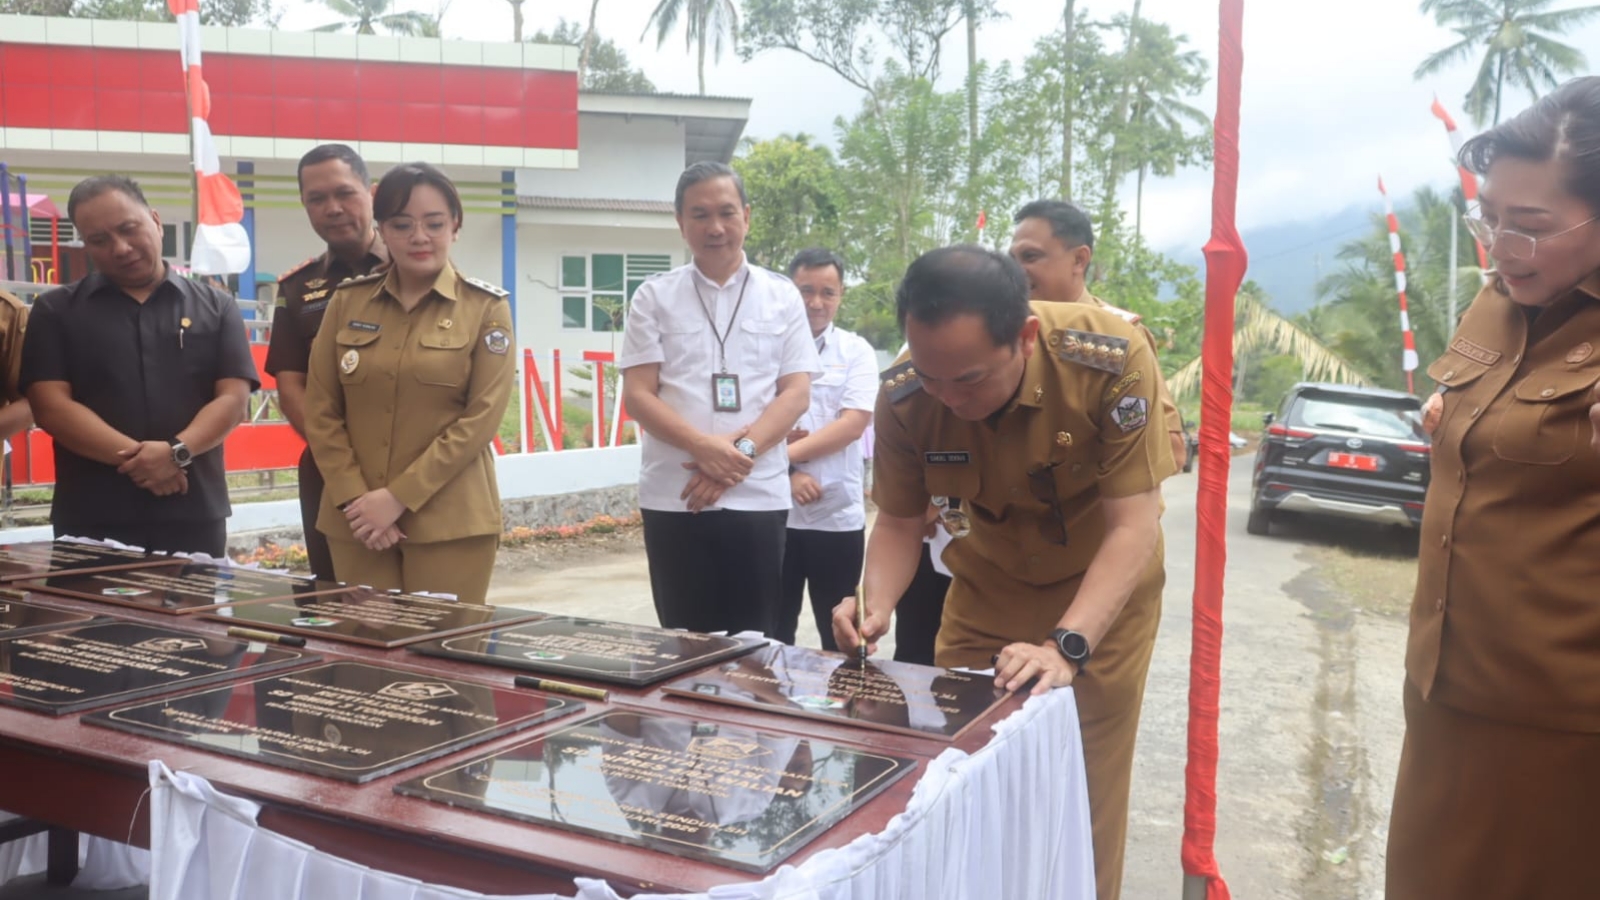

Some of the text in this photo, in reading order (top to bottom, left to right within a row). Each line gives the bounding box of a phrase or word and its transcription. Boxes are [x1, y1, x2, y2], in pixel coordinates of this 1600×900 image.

[561, 746, 591, 756] SD
[716, 776, 805, 798] WALIAN
[622, 748, 764, 780] REVITALISASI
